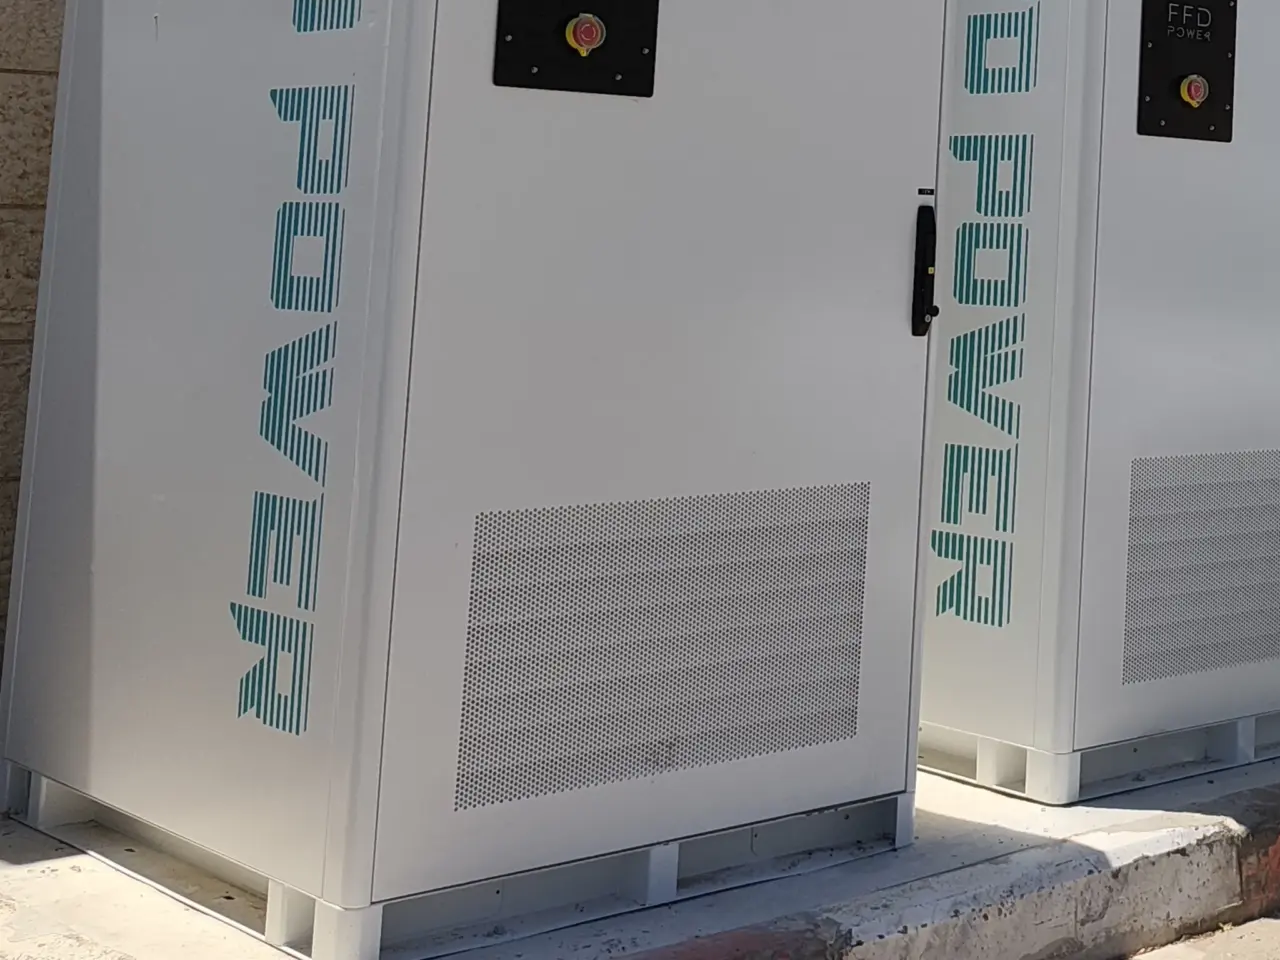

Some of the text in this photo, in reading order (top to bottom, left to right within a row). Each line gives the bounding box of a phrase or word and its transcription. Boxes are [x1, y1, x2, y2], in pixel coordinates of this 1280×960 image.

[1167, 25, 1211, 41] POWER
[1168, 3, 1212, 27] FFD
[230, 84, 355, 736] POWER
[931, 134, 1034, 628] POWER
